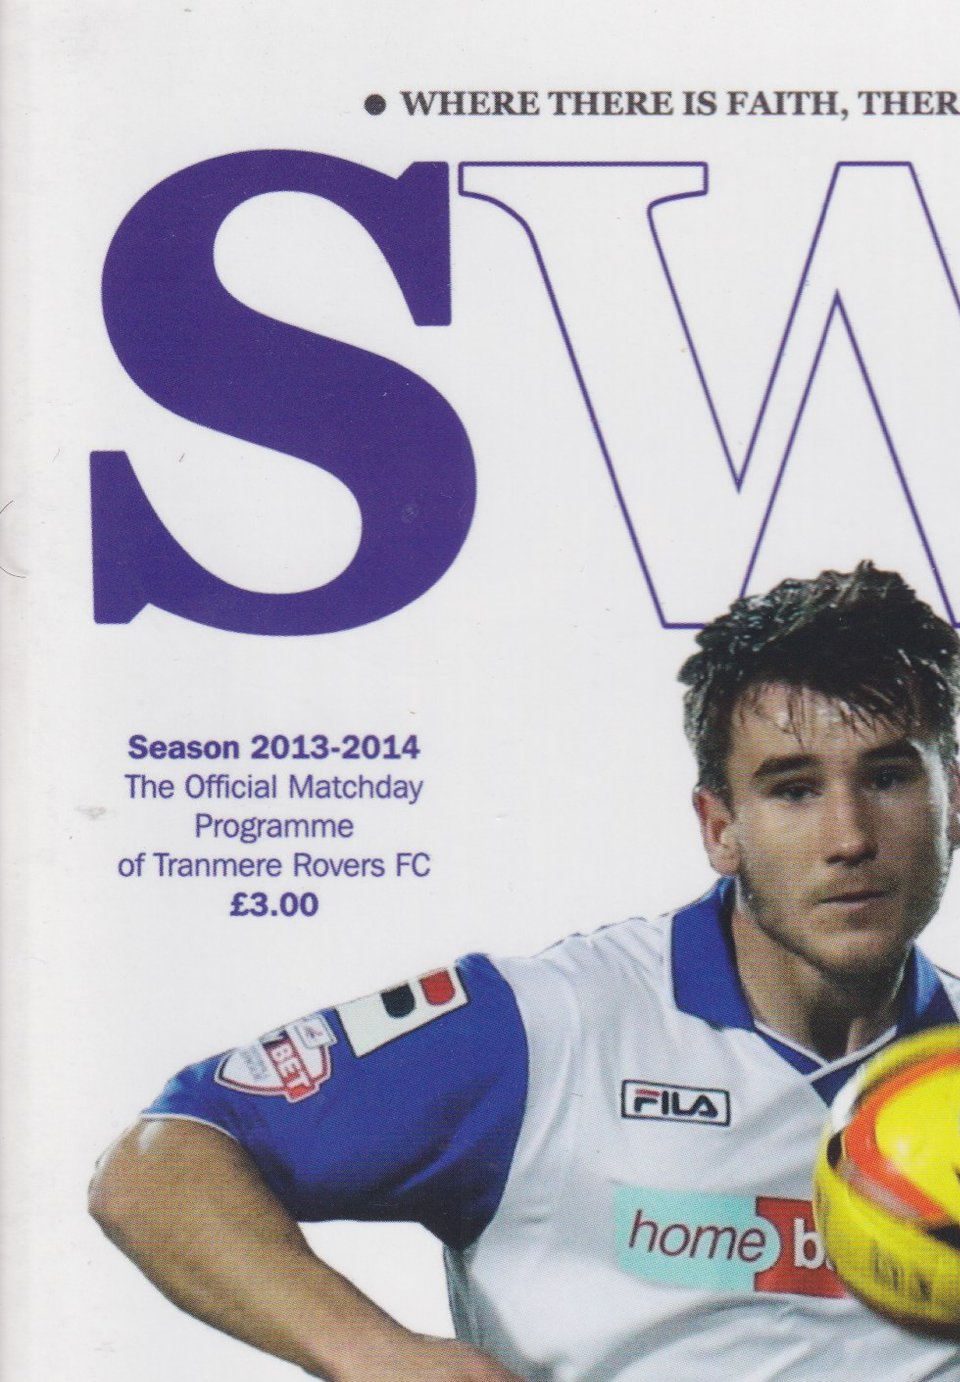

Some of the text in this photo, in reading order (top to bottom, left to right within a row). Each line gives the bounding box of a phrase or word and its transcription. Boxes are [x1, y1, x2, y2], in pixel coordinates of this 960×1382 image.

[399, 88, 541, 118] WHERE
[547, 88, 675, 118] THERE
[681, 88, 719, 118] IS
[725, 88, 851, 122] FAITH,
[126, 732, 423, 762] Season 2013-2014
[122, 772, 425, 806] The Official Matchday
[193, 811, 356, 845] Programme
[116, 851, 433, 879] of Tranmere Rovers FC
[227, 890, 321, 919] £3.00
[271, 1043, 311, 1089] BET
[633, 1089, 718, 1118] FILA
[628, 1211, 766, 1263] home
